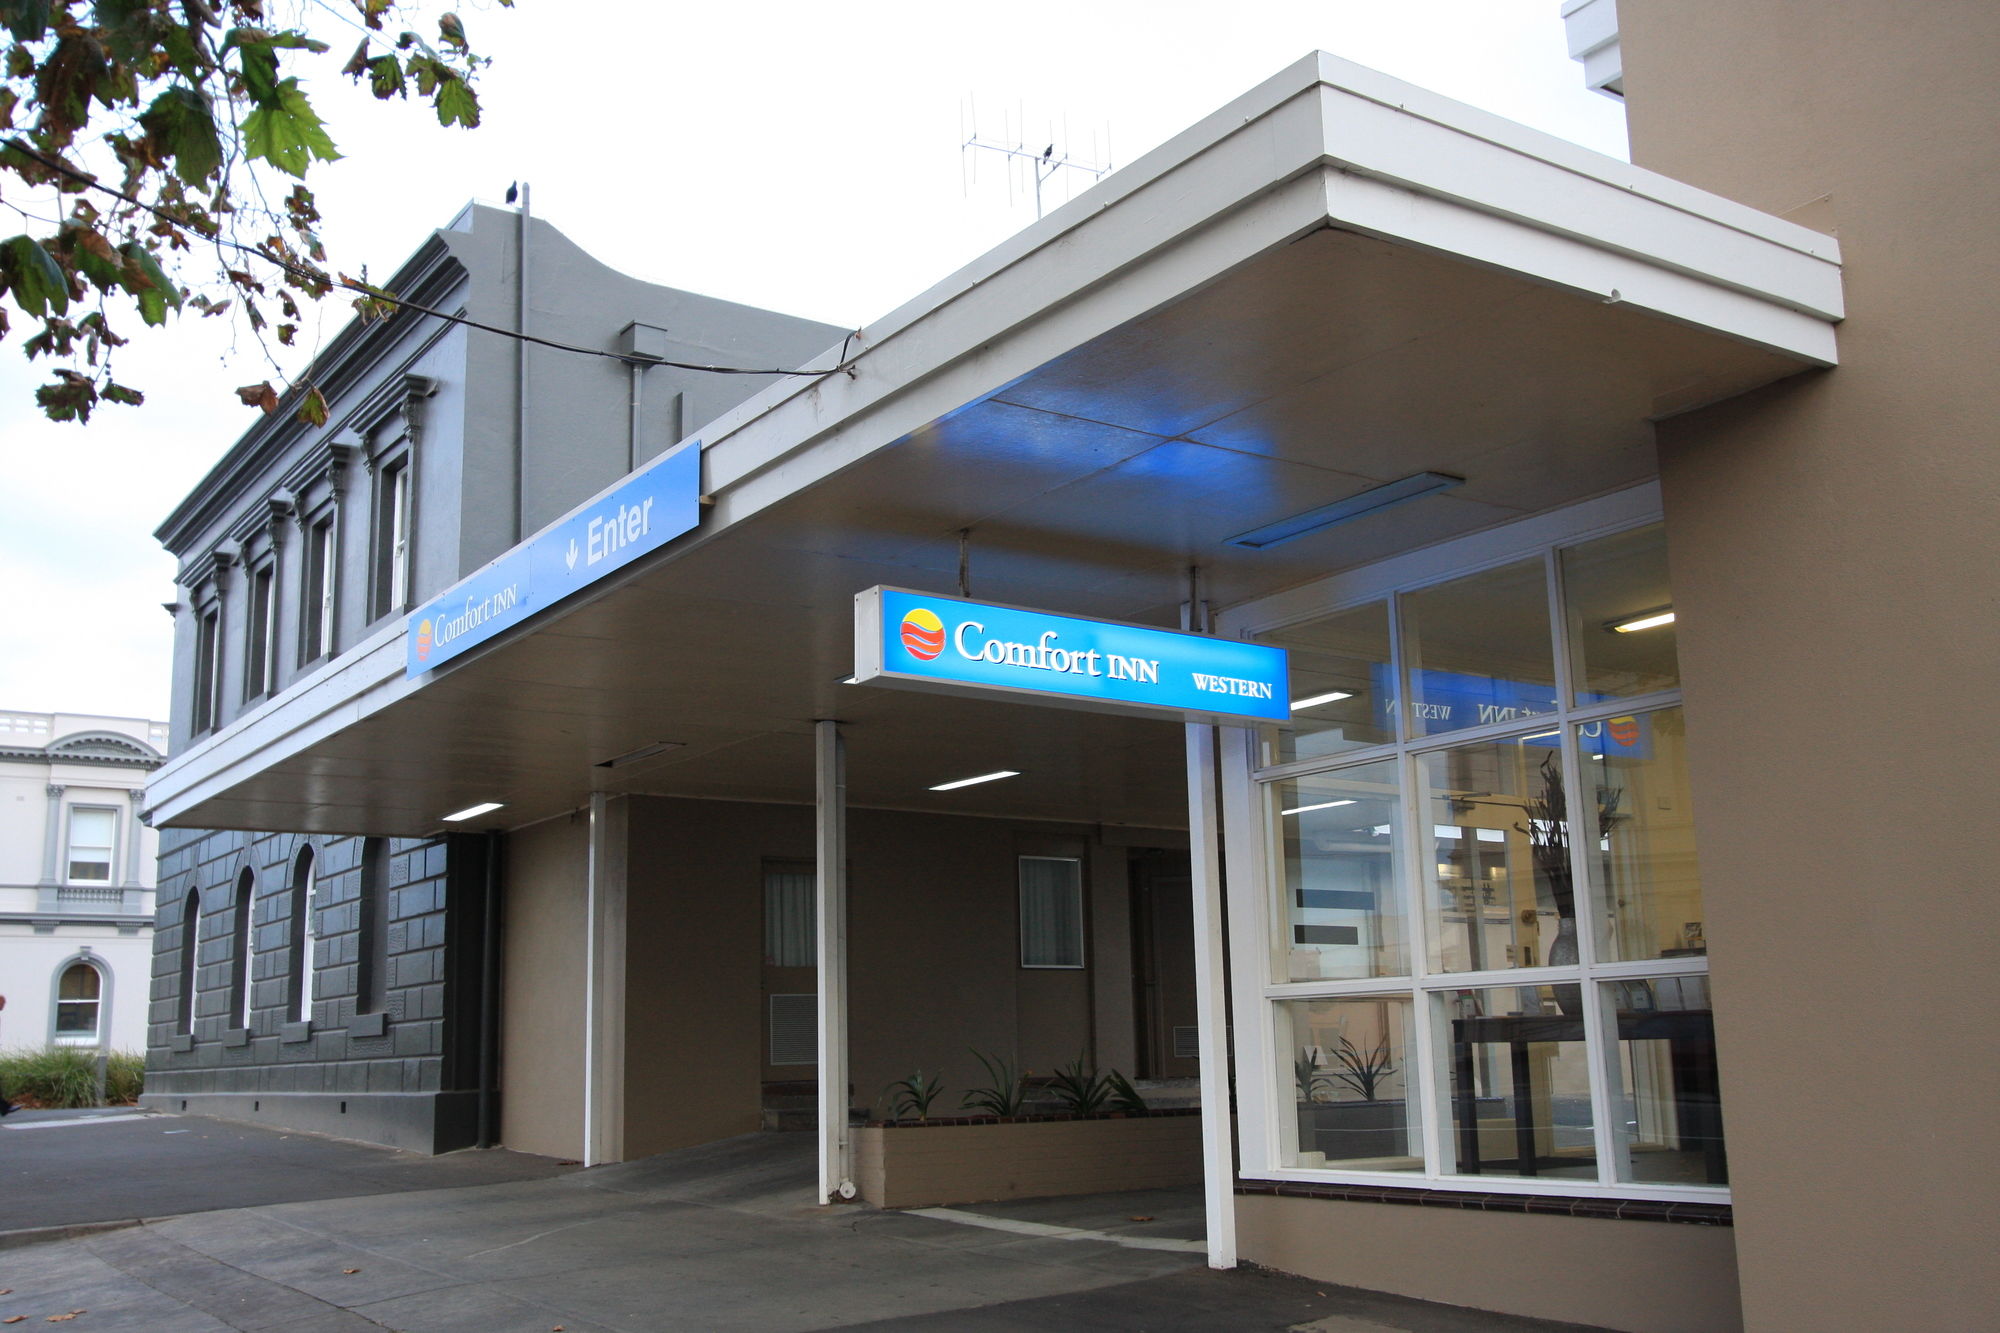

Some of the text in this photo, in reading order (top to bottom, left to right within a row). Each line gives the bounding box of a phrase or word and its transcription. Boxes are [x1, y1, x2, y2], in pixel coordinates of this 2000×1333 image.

[587, 496, 653, 566] Enter
[434, 583, 518, 647] Comfort INN
[954, 621, 1273, 699] Comfort INN WESTERN
